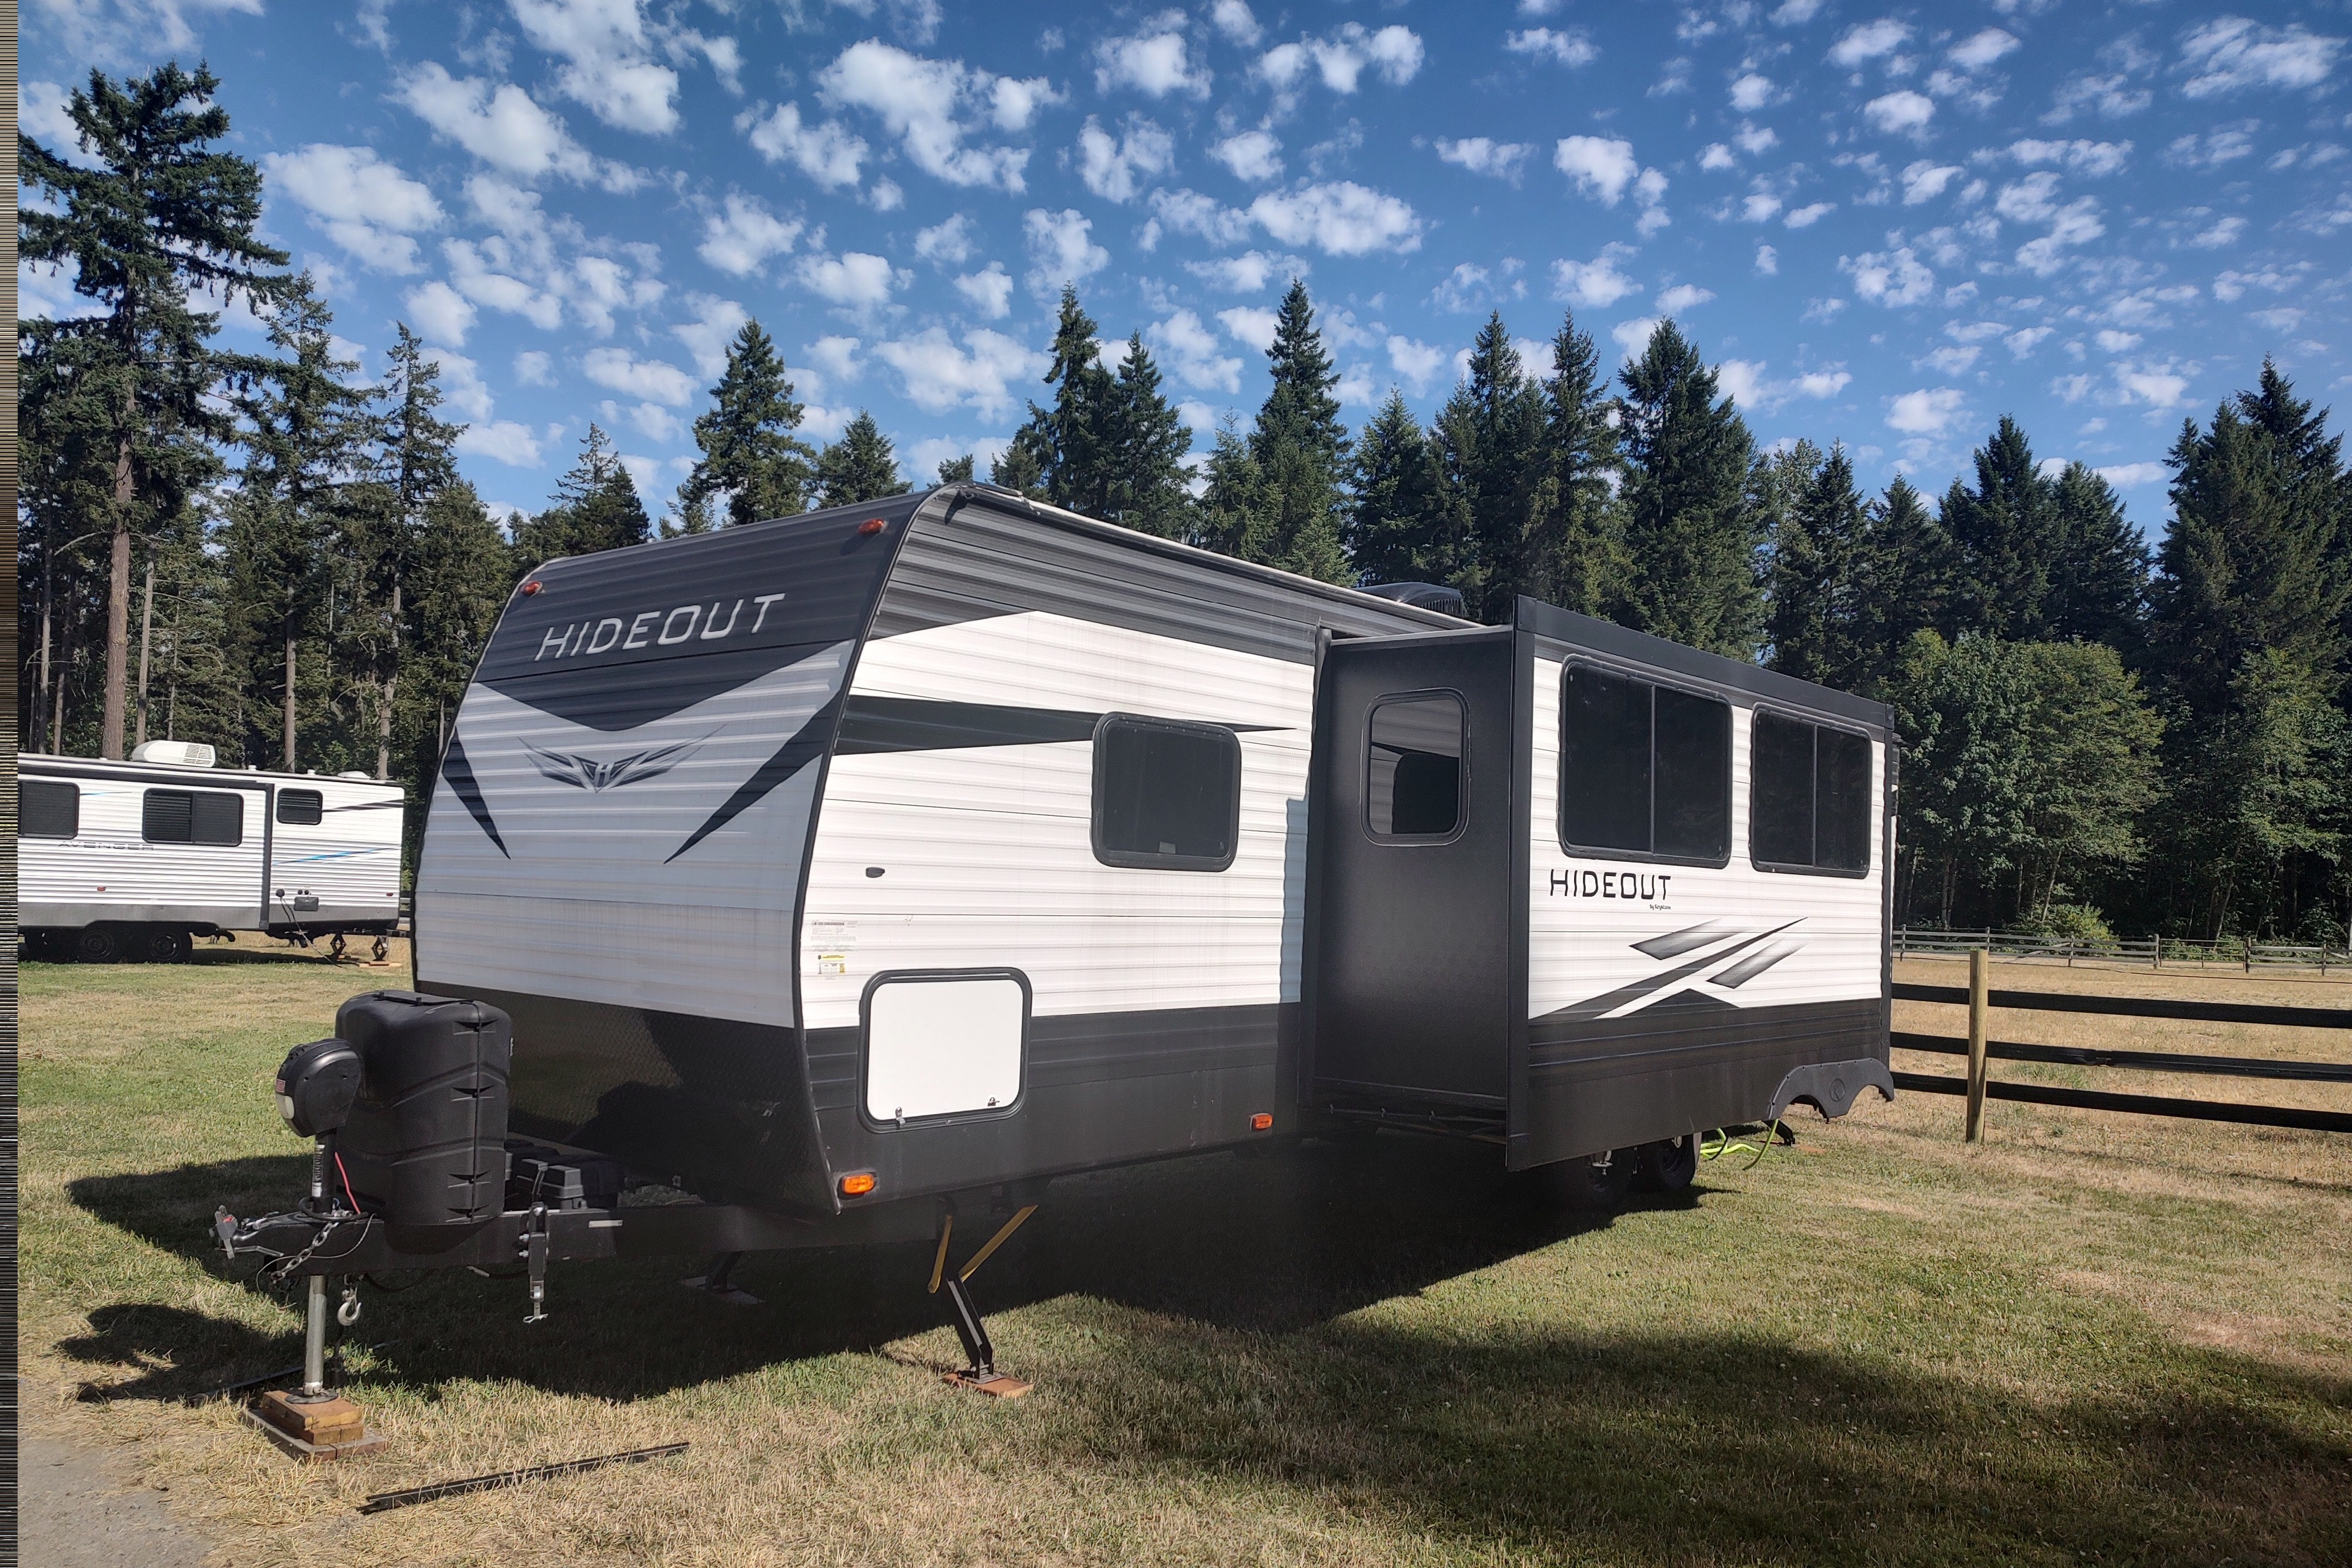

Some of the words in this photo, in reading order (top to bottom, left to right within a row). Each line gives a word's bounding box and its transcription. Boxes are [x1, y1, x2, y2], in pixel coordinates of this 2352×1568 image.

[534, 593, 786, 661] HIDEOUT
[59, 841, 154, 851] AVENGER
[1550, 869, 1671, 900] HIDEOUT
